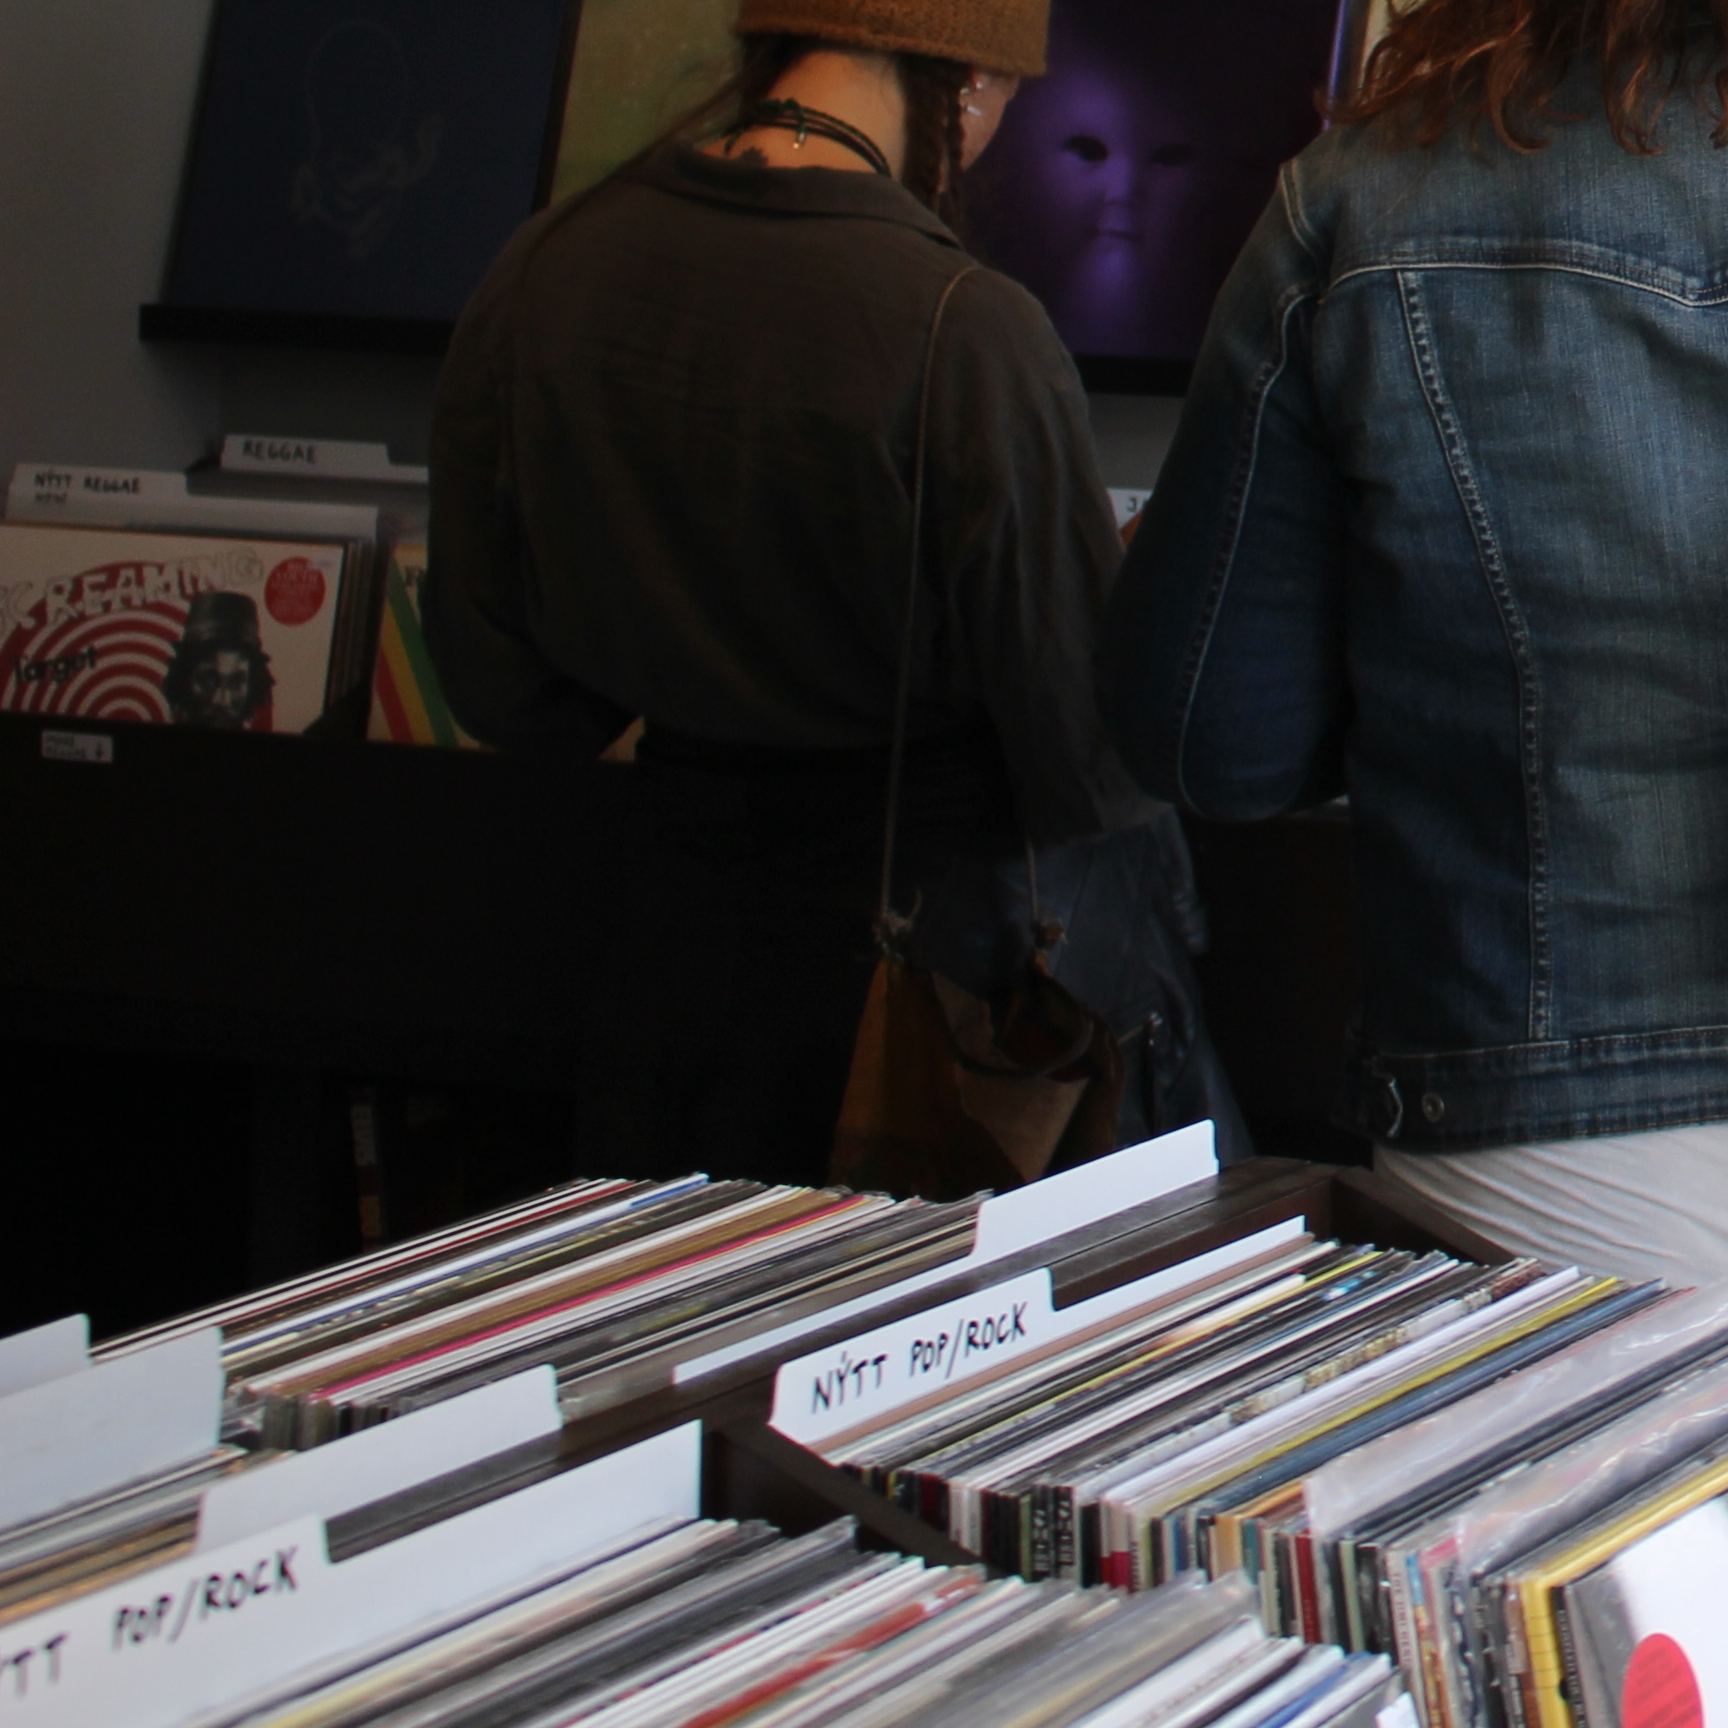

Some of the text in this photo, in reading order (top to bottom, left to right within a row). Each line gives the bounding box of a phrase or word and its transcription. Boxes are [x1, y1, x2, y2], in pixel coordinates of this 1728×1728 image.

[82, 473, 142, 494] REGGAE
[242, 441, 318, 464] REGGAE
[811, 1302, 1028, 1413] NÝTT POP/ROCK
[0, 1547, 299, 1697] TT POP/ROCK
